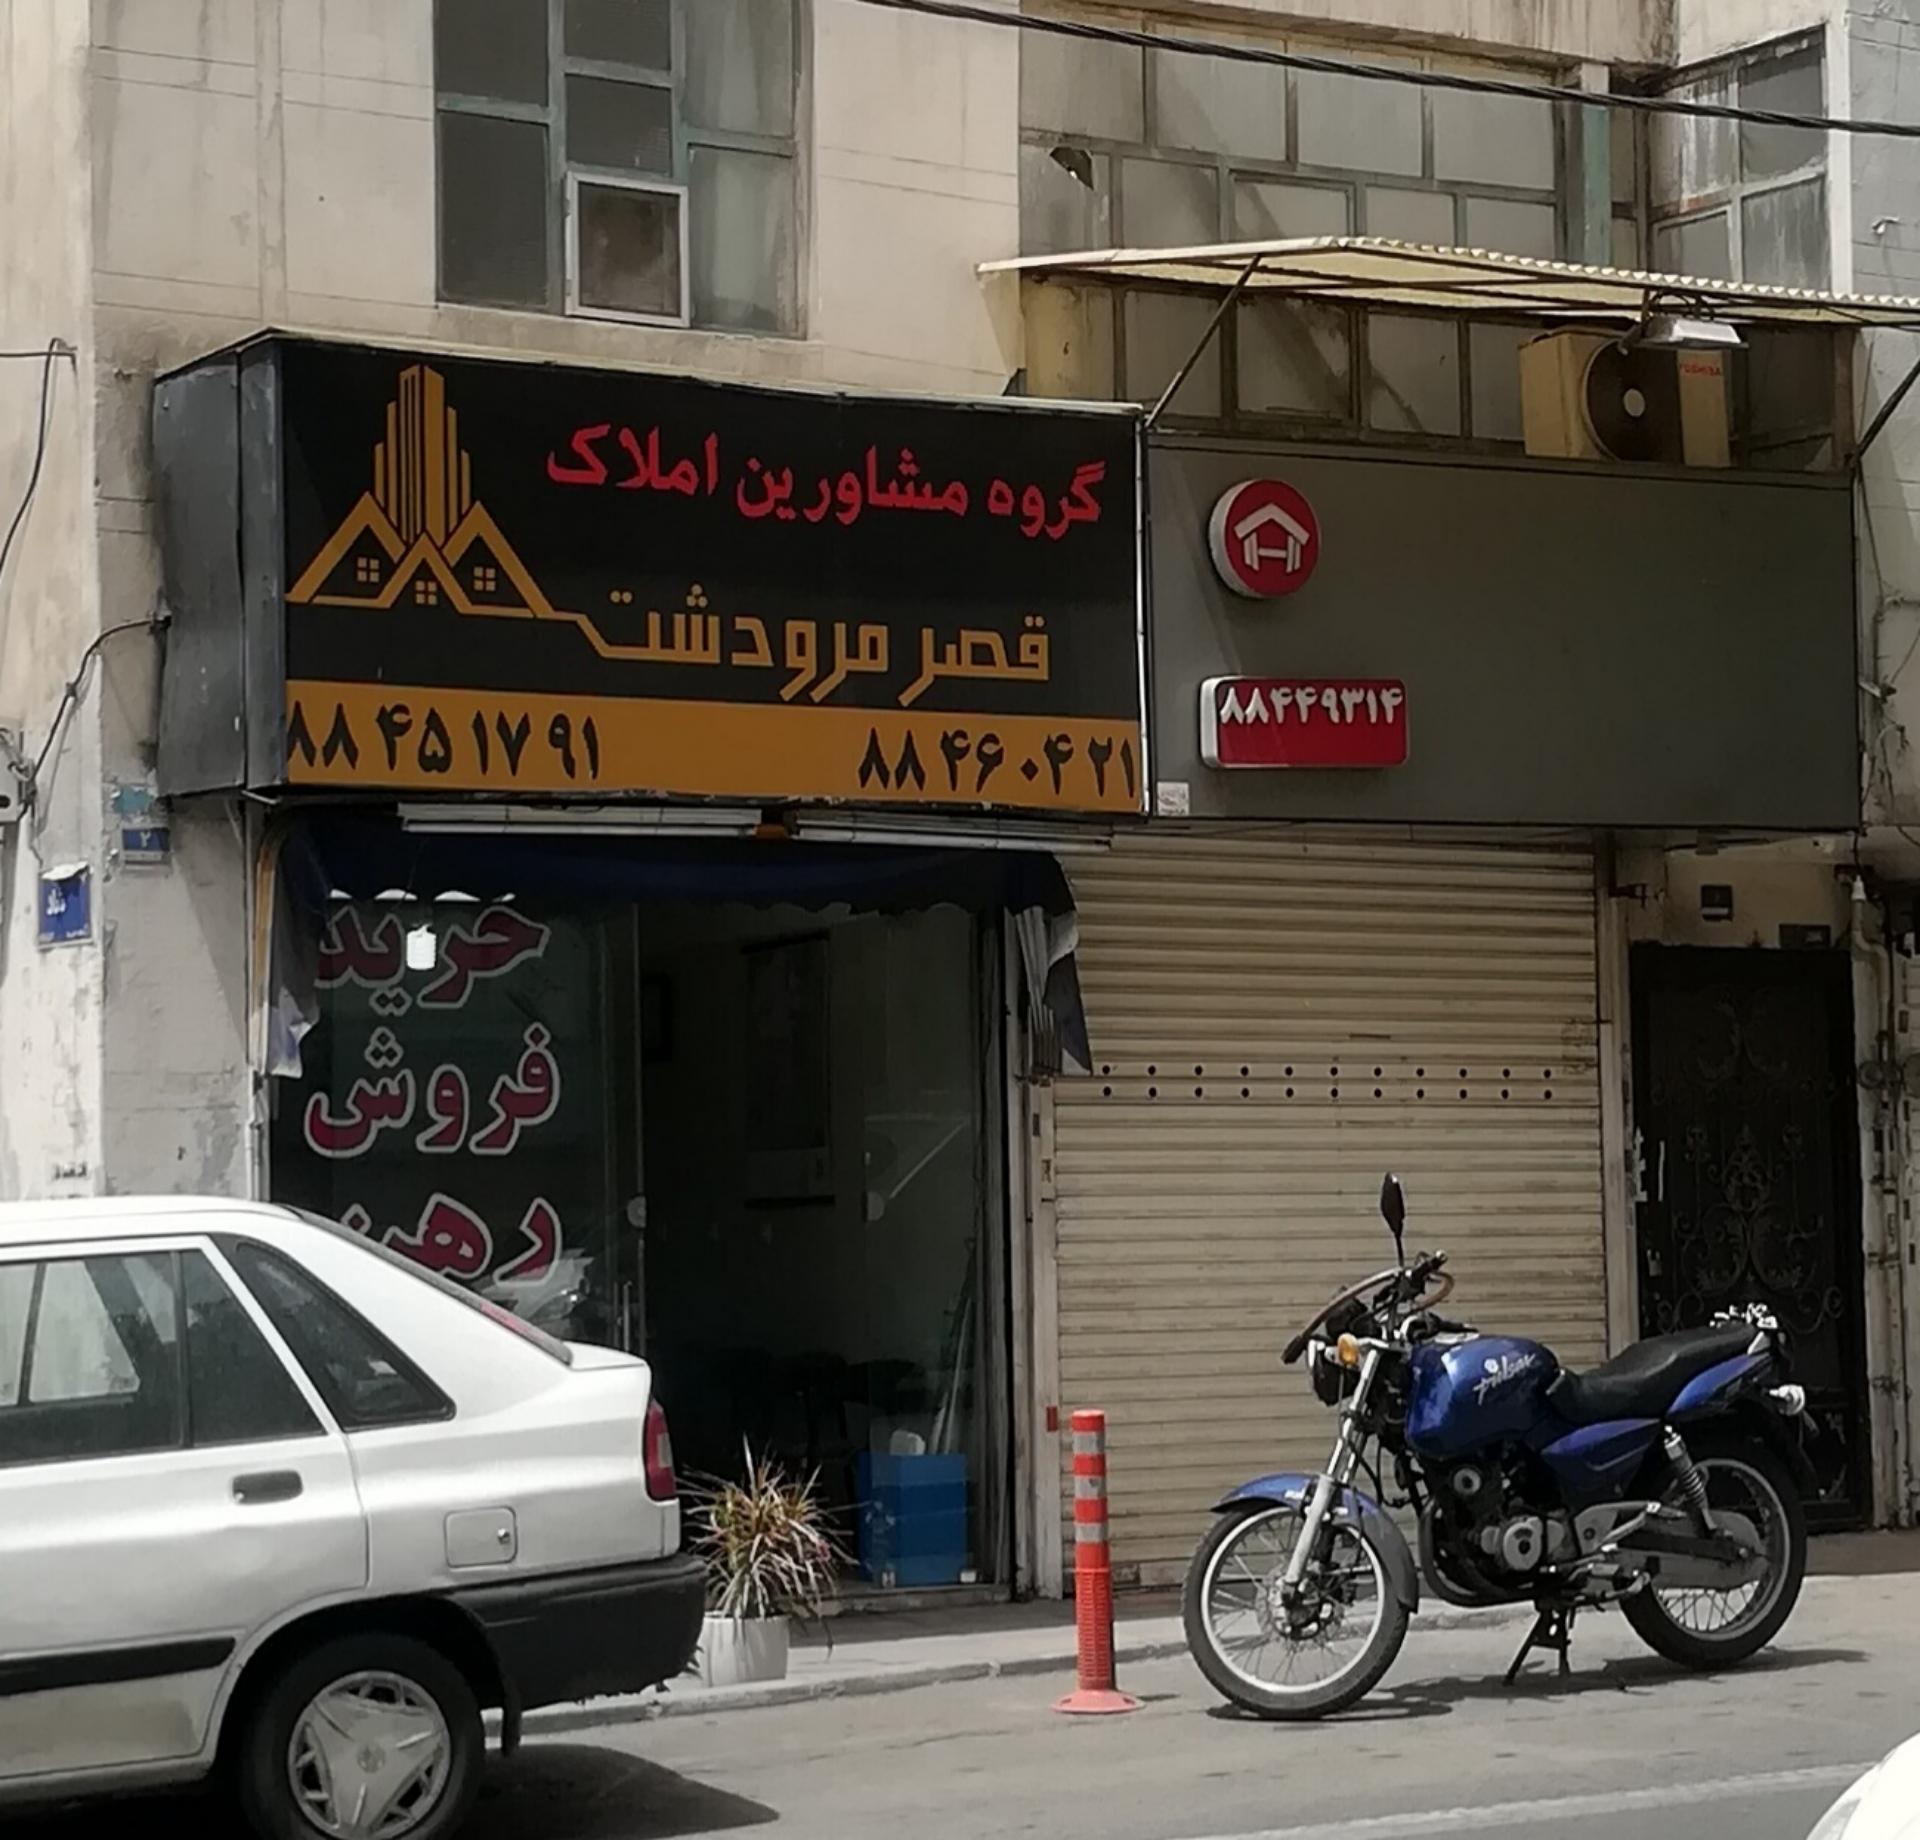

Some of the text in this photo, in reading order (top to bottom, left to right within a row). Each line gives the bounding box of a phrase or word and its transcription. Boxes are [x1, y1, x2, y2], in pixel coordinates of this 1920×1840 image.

[547, 423, 1106, 540] گروه مشاورین املاک
[590, 583, 1049, 708] قصر مرودشت
[1219, 685, 1404, 725] ۸۸۴۴۹۳۱۴
[305, 1022, 561, 1158] فروش
